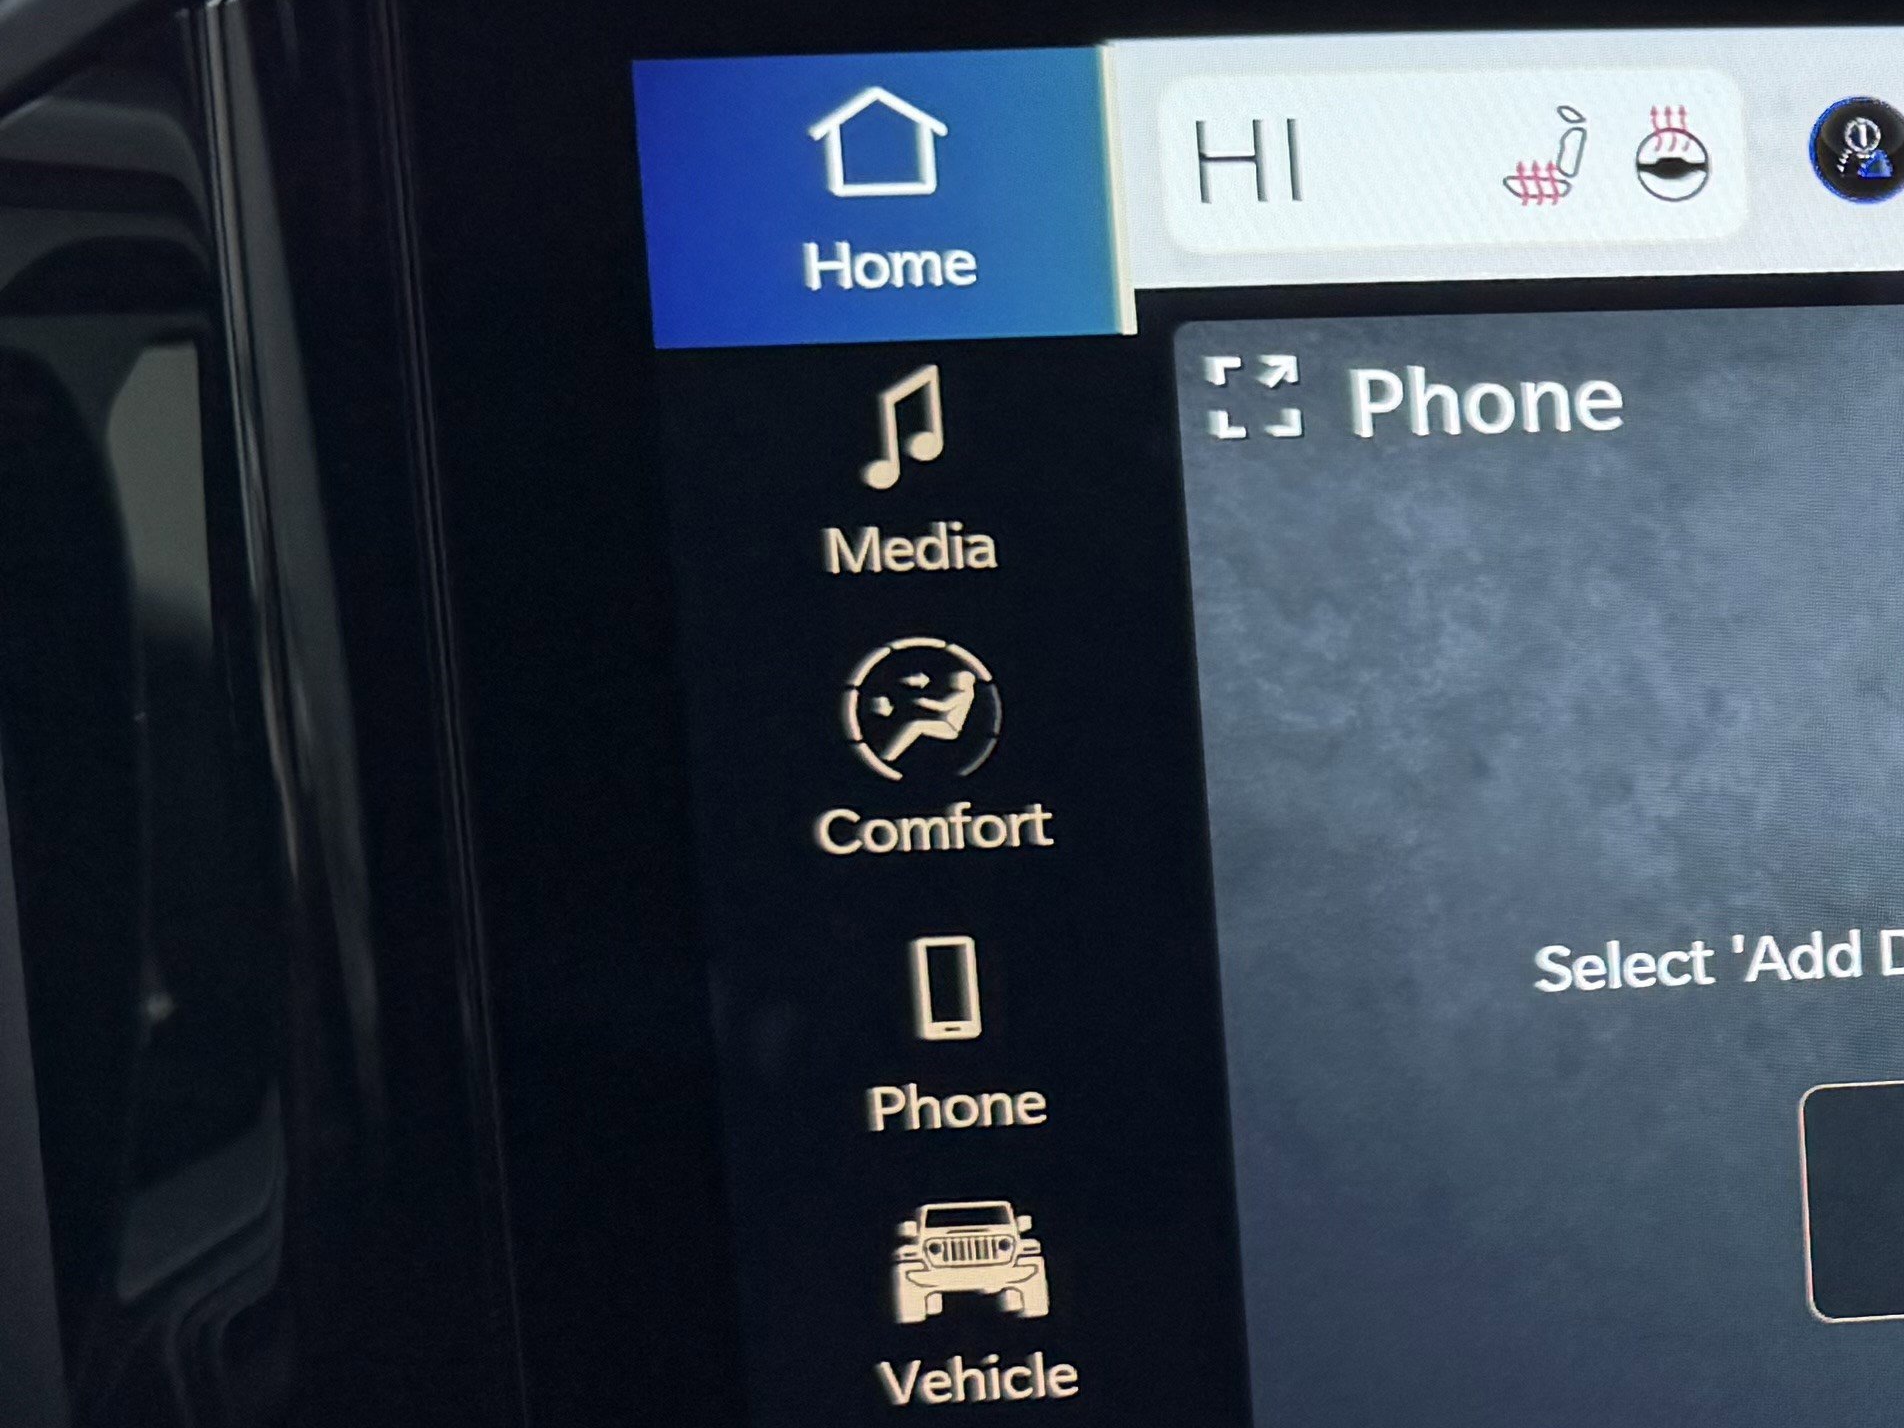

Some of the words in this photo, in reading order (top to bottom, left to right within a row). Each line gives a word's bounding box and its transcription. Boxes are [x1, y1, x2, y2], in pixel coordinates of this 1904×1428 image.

[1194, 119, 1303, 203] HI
[801, 241, 977, 291] Home
[1350, 364, 1623, 438] Phone
[823, 521, 998, 573] Media
[814, 802, 1054, 854] Comfort
[1534, 939, 1711, 995] Select
[1731, 927, 1863, 984] 'Add
[867, 1083, 1047, 1132] Phone
[874, 1351, 1078, 1405] Vehicle
